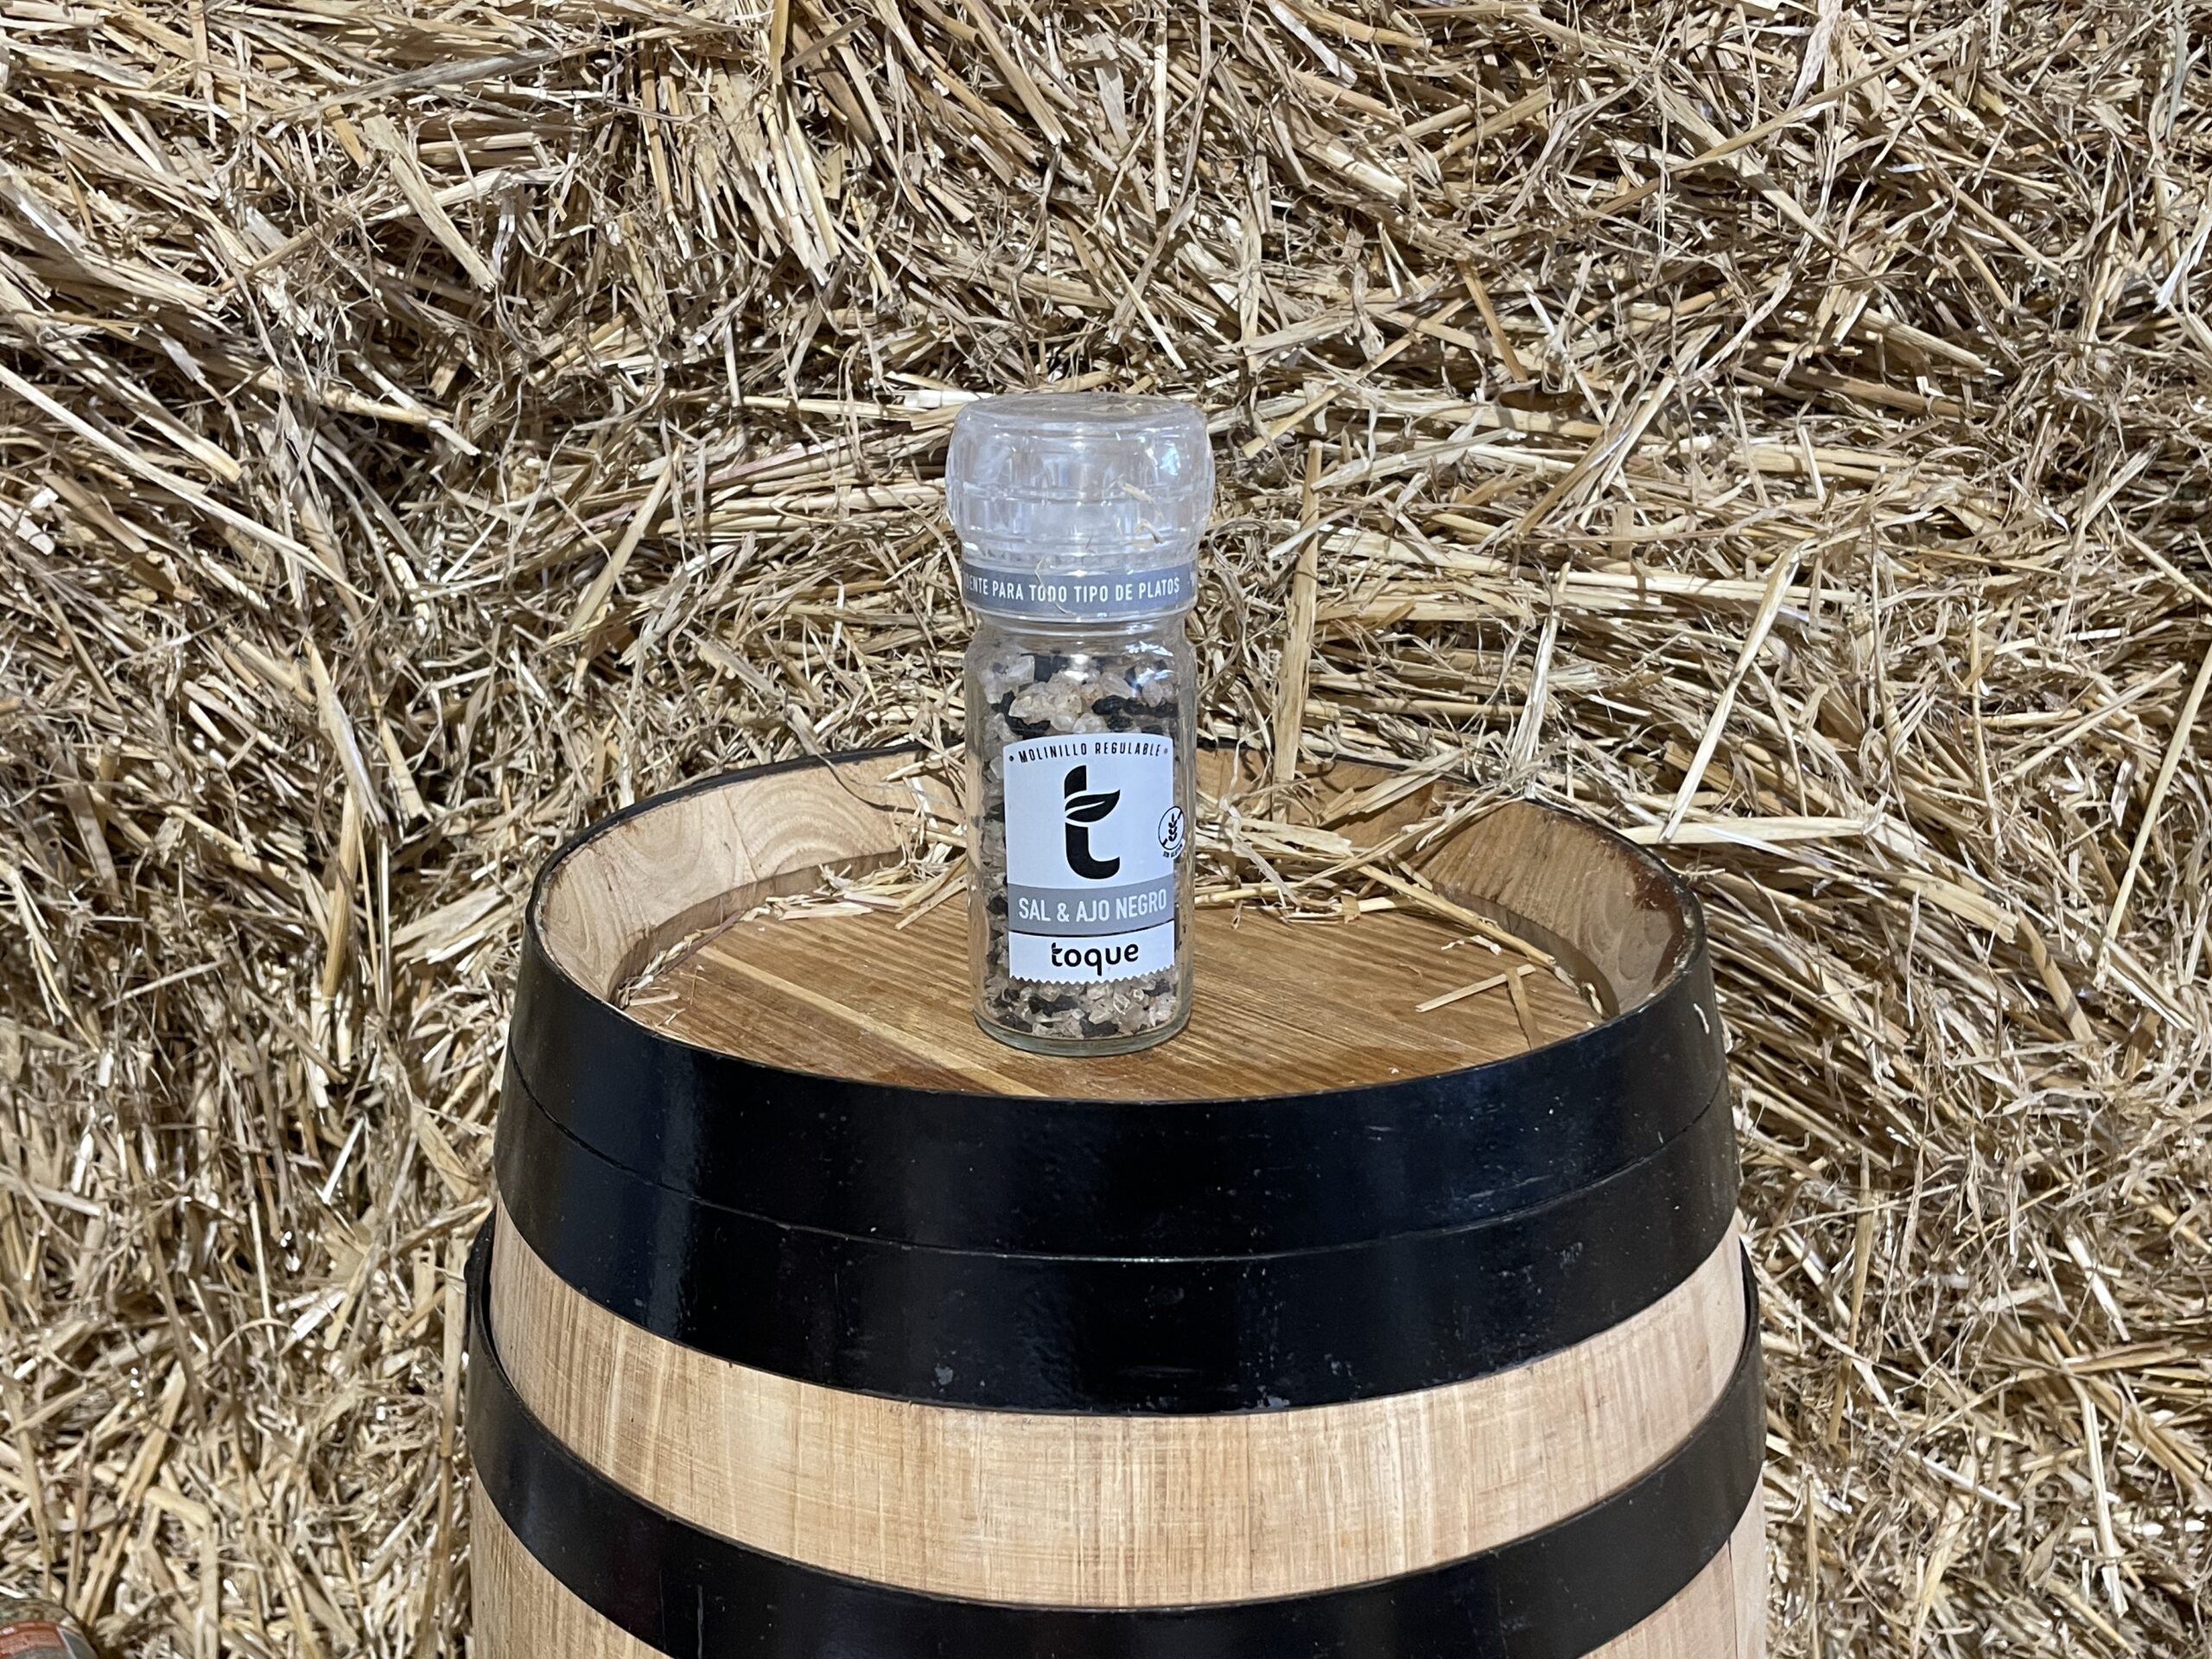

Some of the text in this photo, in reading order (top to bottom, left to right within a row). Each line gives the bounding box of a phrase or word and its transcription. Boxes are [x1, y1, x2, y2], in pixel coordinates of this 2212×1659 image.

[992, 581, 1024, 601] PARA
[1028, 584, 1067, 602] TODO
[1073, 586, 1109, 602] TIPO
[1116, 584, 1133, 601] DE
[1138, 576, 1180, 599] PLATOS
[1018, 741, 1161, 764] MOLINILLO REGULABLE
[1019, 888, 1166, 923] SAL & AJO NEGRO
[1051, 942, 1140, 976] toque
